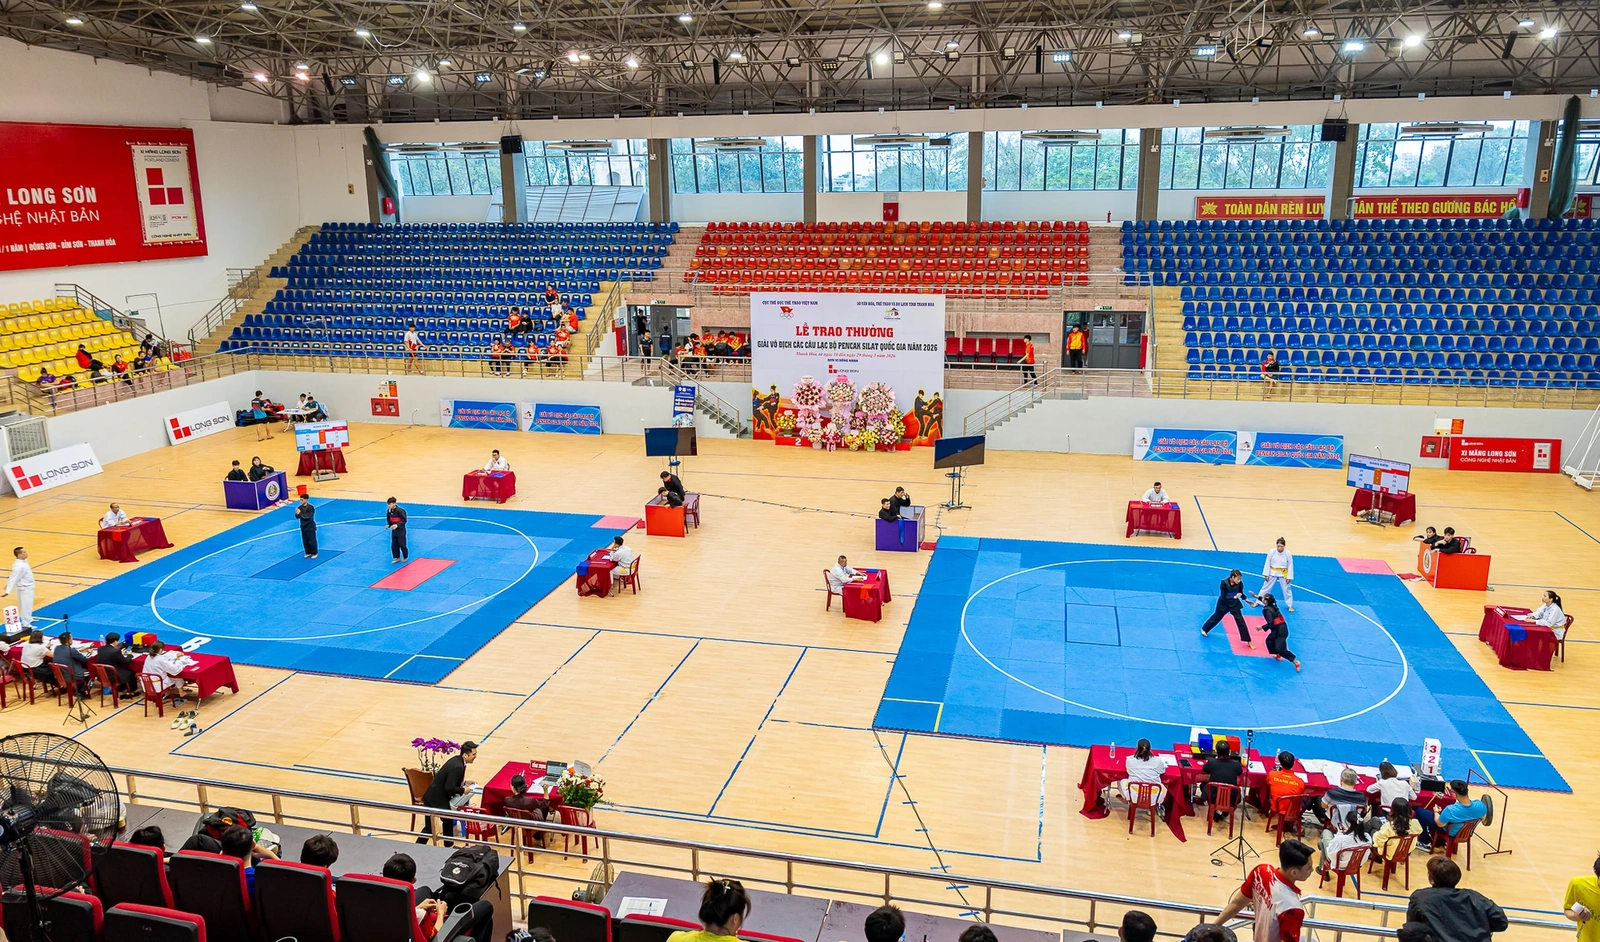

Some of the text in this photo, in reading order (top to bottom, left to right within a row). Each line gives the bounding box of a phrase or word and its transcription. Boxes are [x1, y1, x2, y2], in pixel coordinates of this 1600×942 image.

[7, 185, 97, 205] LONG SƠN
[1225, 201, 1252, 214] TOÀN
[1255, 201, 1278, 214] DÂN
[1281, 201, 1303, 214] RÈN
[1378, 197, 1399, 214] THỂ
[1401, 202, 1429, 214] THEO
[1432, 201, 1470, 214] GƯƠNG
[1474, 200, 1497, 213] BÁC
[27, 209, 66, 226] NHẬT
[71, 207, 100, 222] BẢN
[10, 243, 24, 252] NĂM
[29, 242, 44, 251] ĐÔNG
[45, 242, 56, 250] SƠN
[105, 237, 116, 246] HÓA
[796, 322, 893, 337] LỄ TRAO THƯỞNG
[758, 339, 769, 348] GIẢI
[779, 341, 792, 349] ĐỊCH
[793, 341, 804, 349] CÁC
[817, 342, 828, 350] LẠC
[829, 342, 837, 351] BỘ
[880, 341, 895, 351] QUỐC
[908, 342, 922, 351] NĂM
[190, 415, 230, 431] LONG SON
[40, 459, 94, 480] LONG SON
